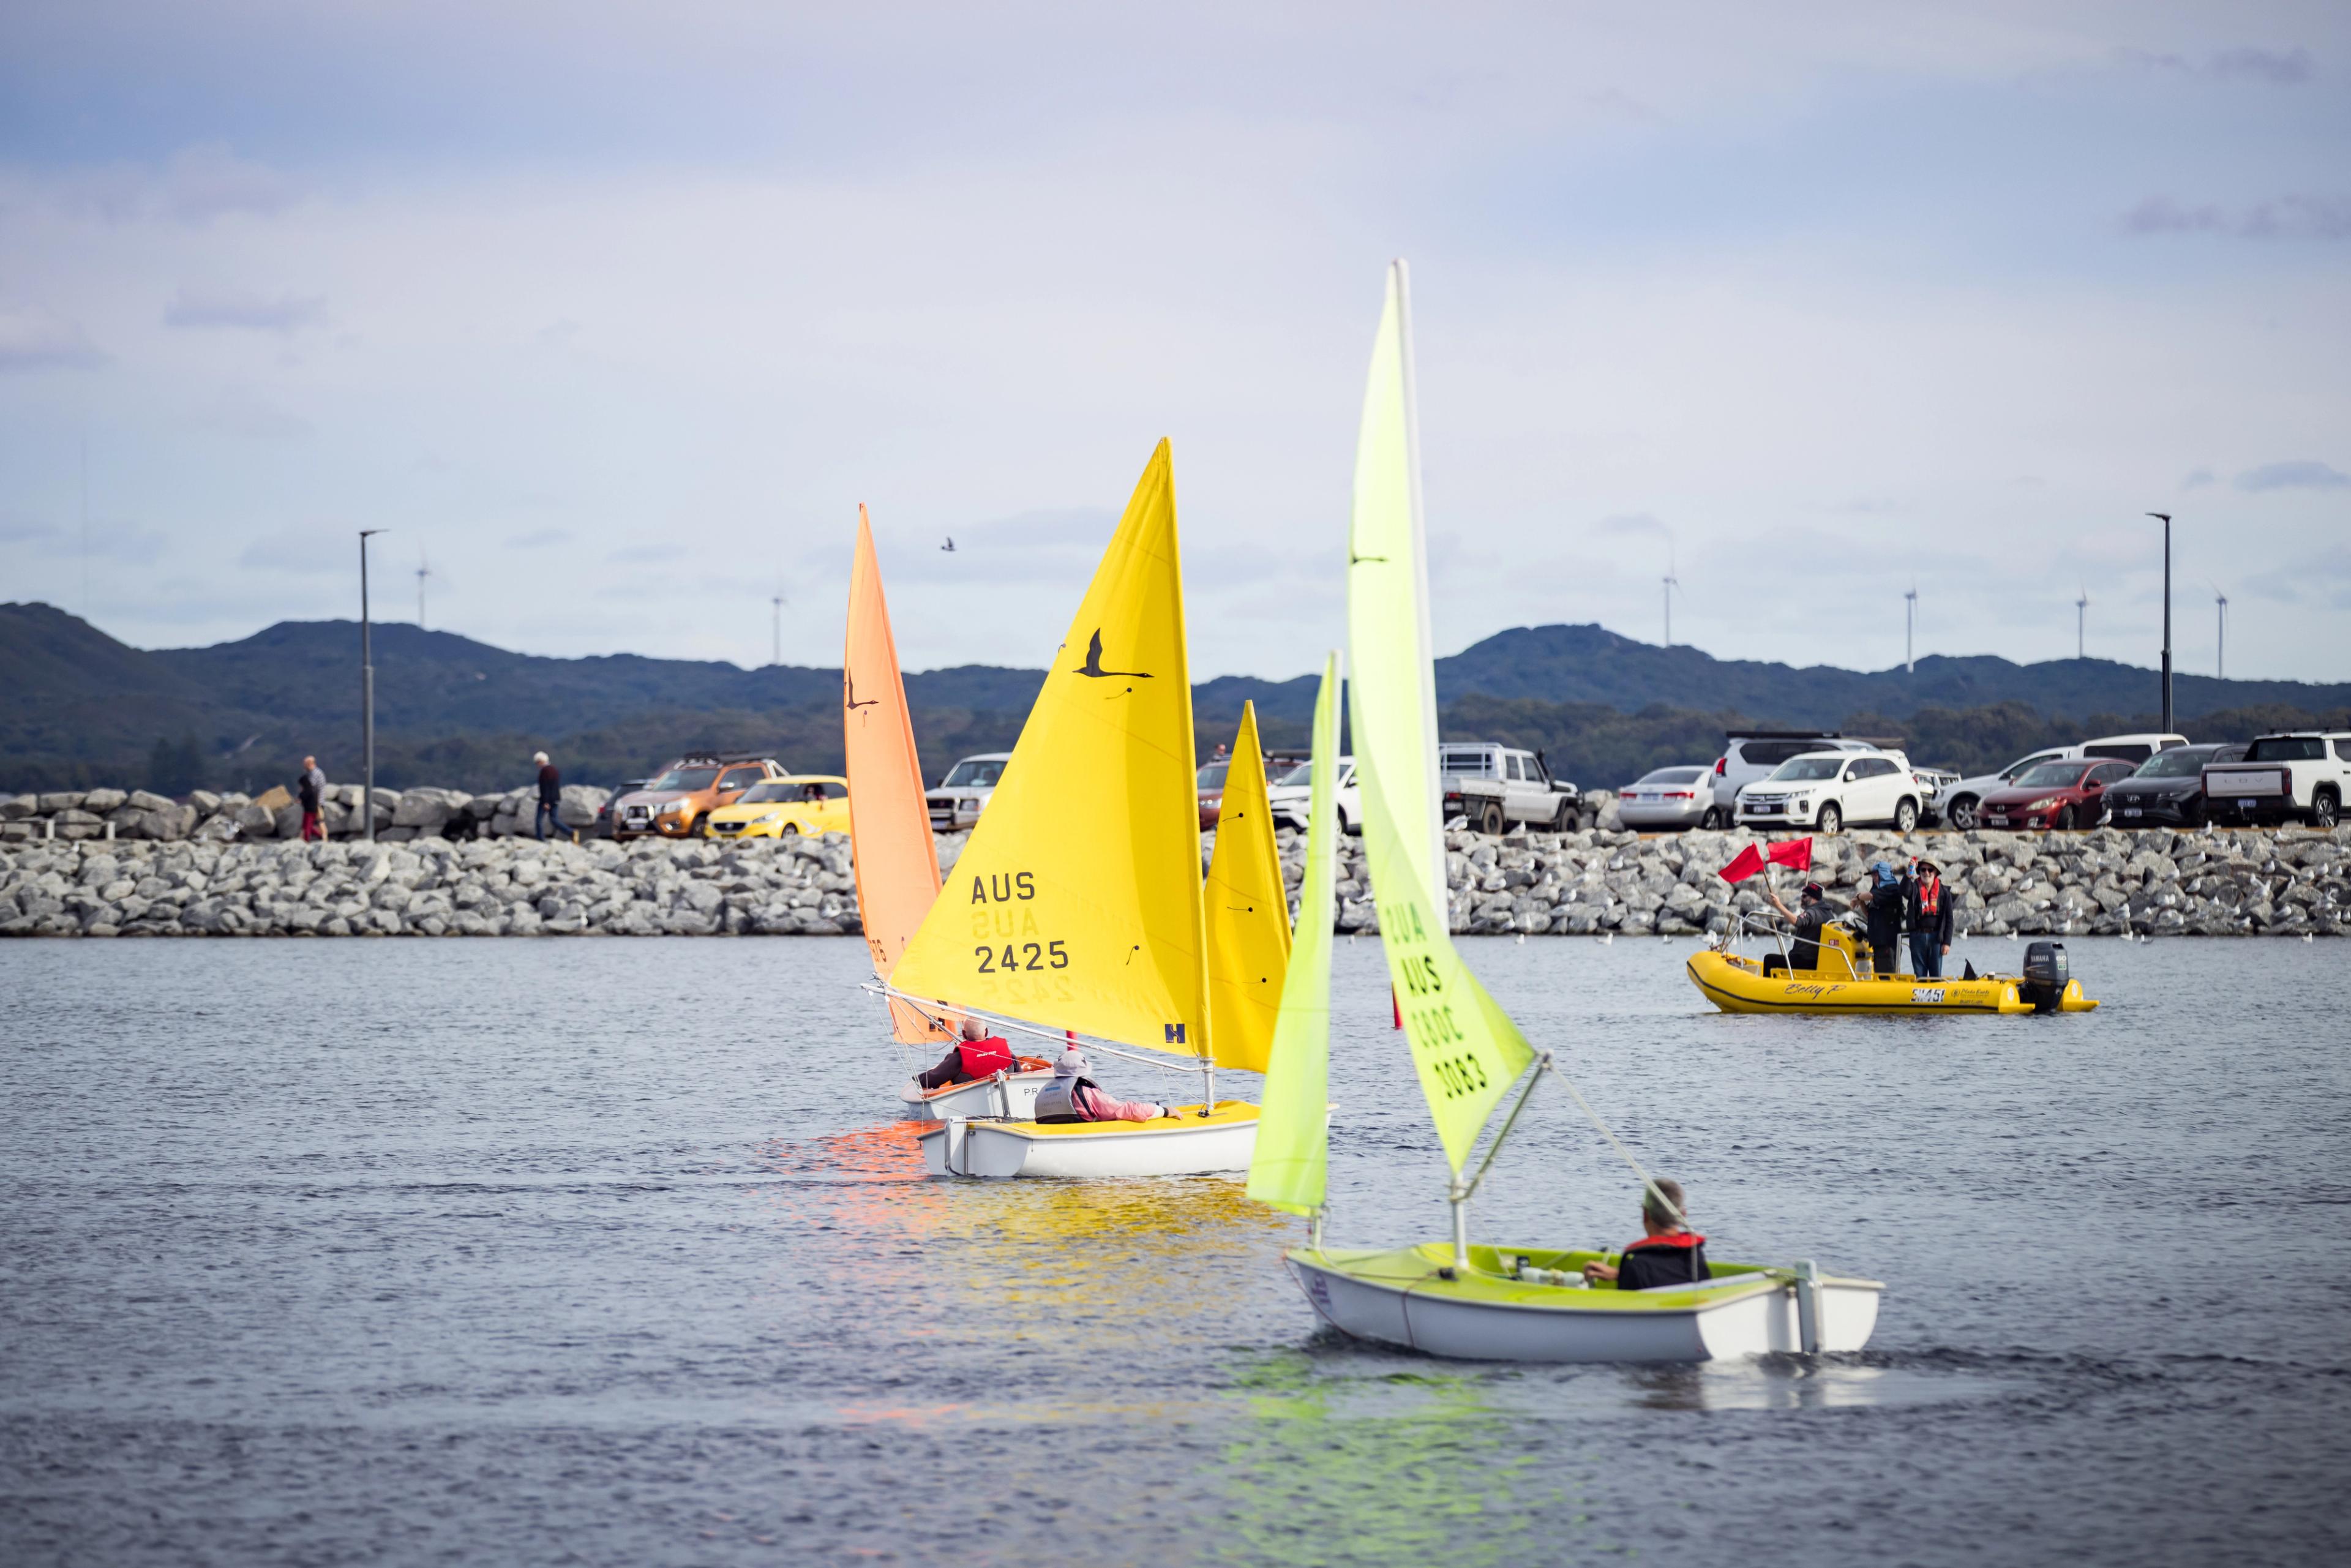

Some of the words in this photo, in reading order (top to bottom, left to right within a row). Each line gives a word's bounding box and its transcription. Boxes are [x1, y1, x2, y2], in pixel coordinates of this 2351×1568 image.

[972, 872, 1035, 904] AUS
[975, 940, 1068, 973] 2425
[1401, 956, 1441, 997] AUS
[1164, 1023, 1185, 1043] H
